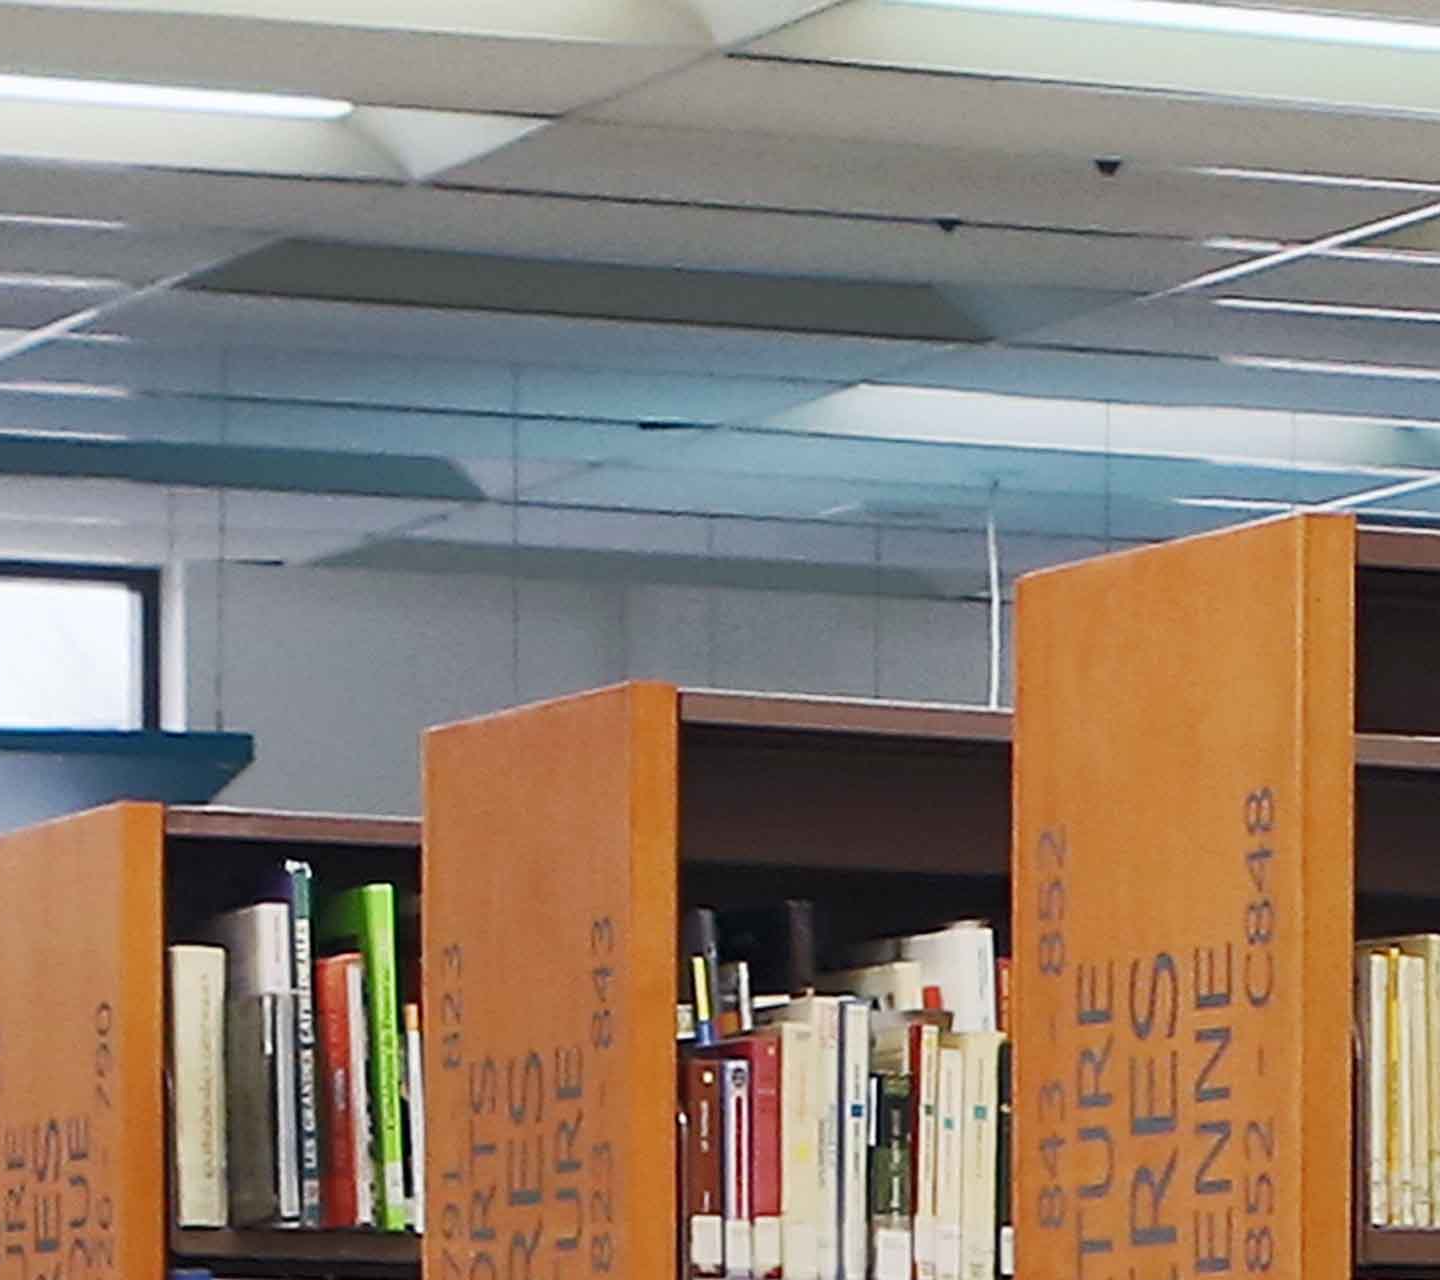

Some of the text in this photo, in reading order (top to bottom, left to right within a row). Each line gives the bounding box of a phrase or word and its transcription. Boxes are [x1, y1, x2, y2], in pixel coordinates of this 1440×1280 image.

[1037, 826, 1066, 977] 852
[1246, 785, 1276, 1008] C848
[1037, 1078, 1067, 1232] 843
[1246, 1117, 1276, 1274] 852
